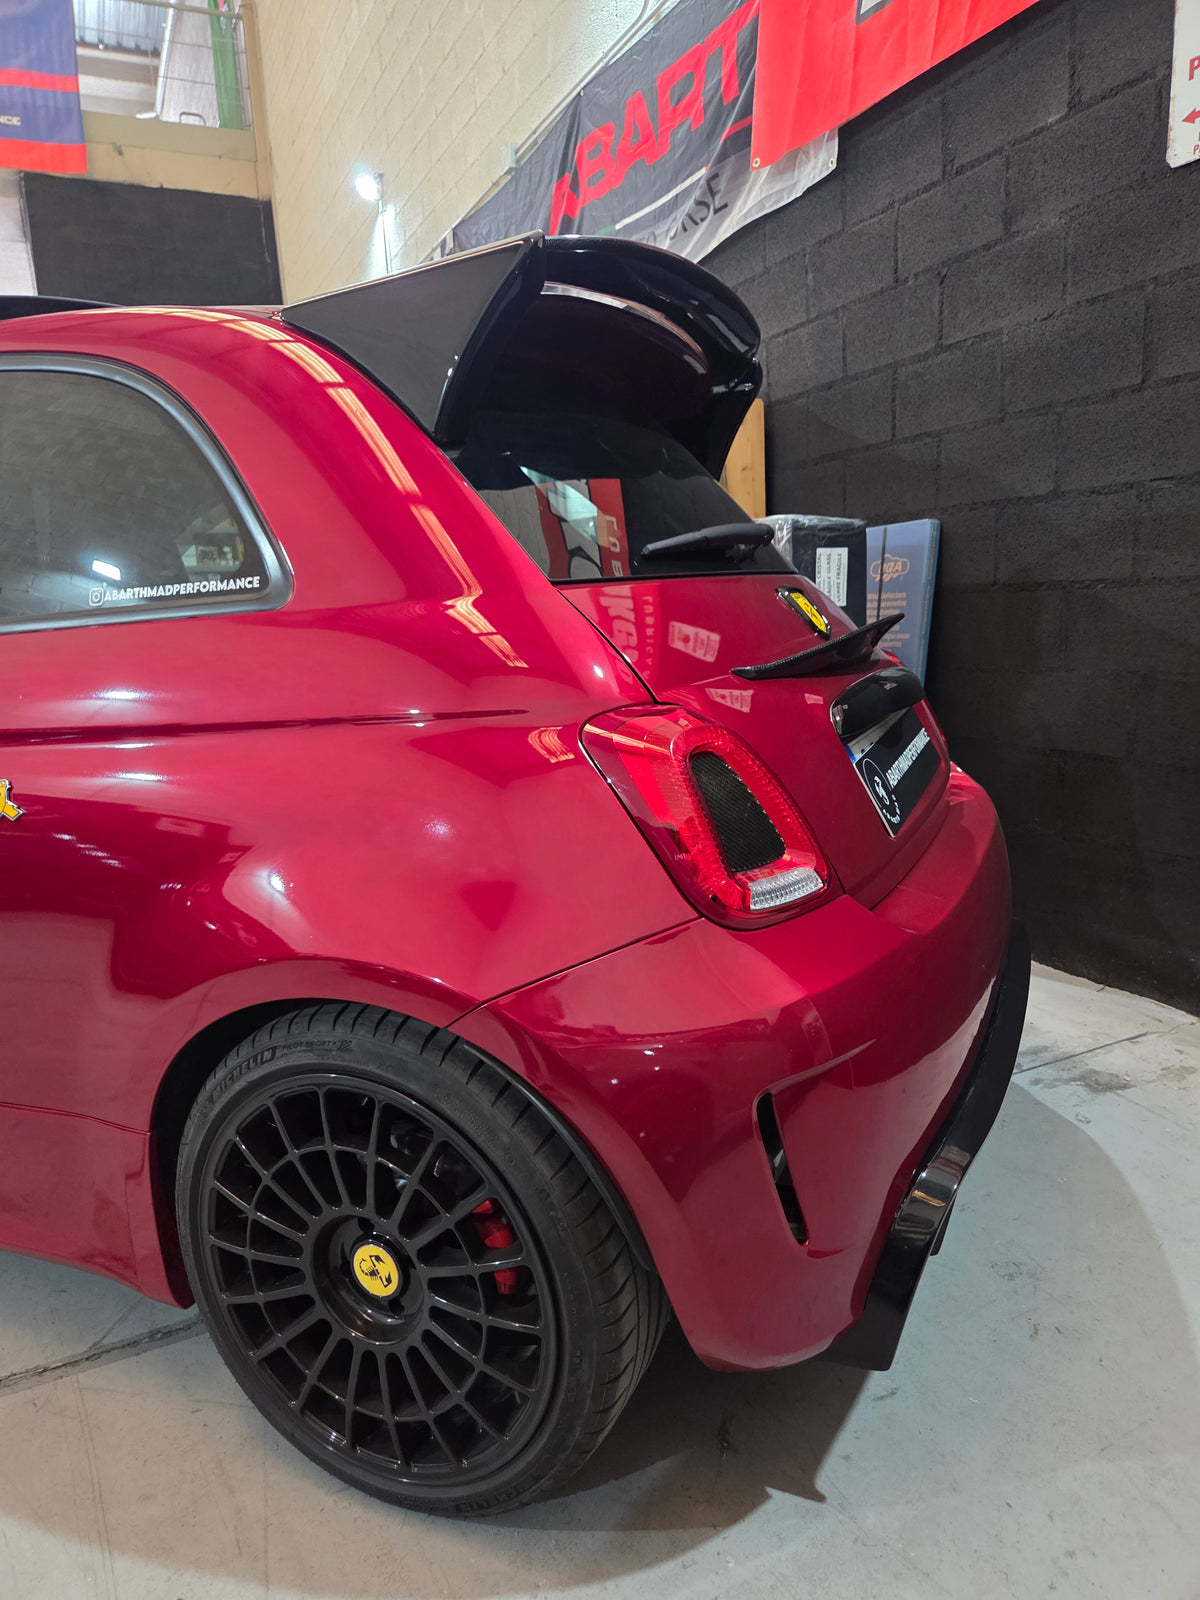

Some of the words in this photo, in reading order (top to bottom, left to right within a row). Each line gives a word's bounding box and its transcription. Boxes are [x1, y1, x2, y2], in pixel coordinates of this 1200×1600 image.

[549, 0, 760, 236] ABART
[104, 576, 260, 600] ABARTHMADPERFORMANCE
[211, 1047, 275, 1101] MICHELIN
[282, 1041, 304, 1051] PILOT
[304, 1040, 331, 1048] SPORT
